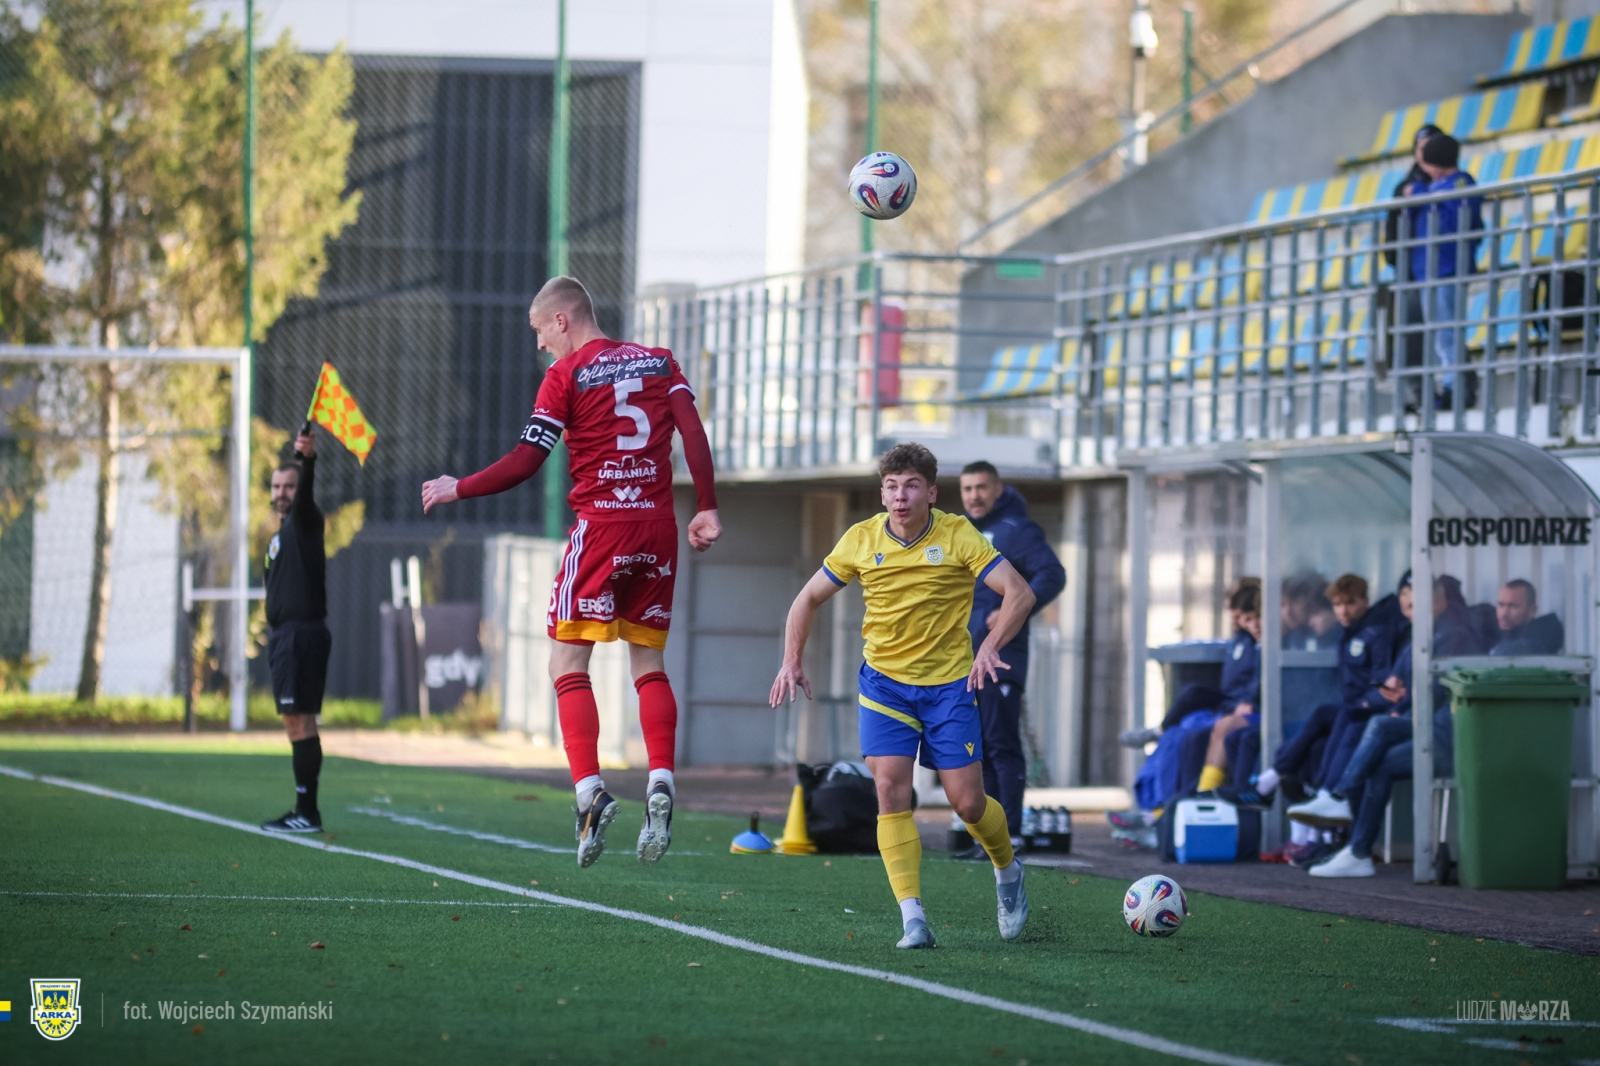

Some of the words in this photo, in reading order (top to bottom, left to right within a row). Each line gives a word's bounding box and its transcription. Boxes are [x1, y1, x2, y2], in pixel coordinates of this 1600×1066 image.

[577, 363, 624, 383] CHLUBA
[625, 356, 667, 372] GRODU
[607, 372, 640, 383] TURA
[613, 377, 651, 451] 5
[598, 466, 657, 479] URBANIAK
[1428, 517, 1592, 546] GOSPODARZE
[613, 553, 657, 566] PRESTO
[578, 598, 615, 614] ERMO
